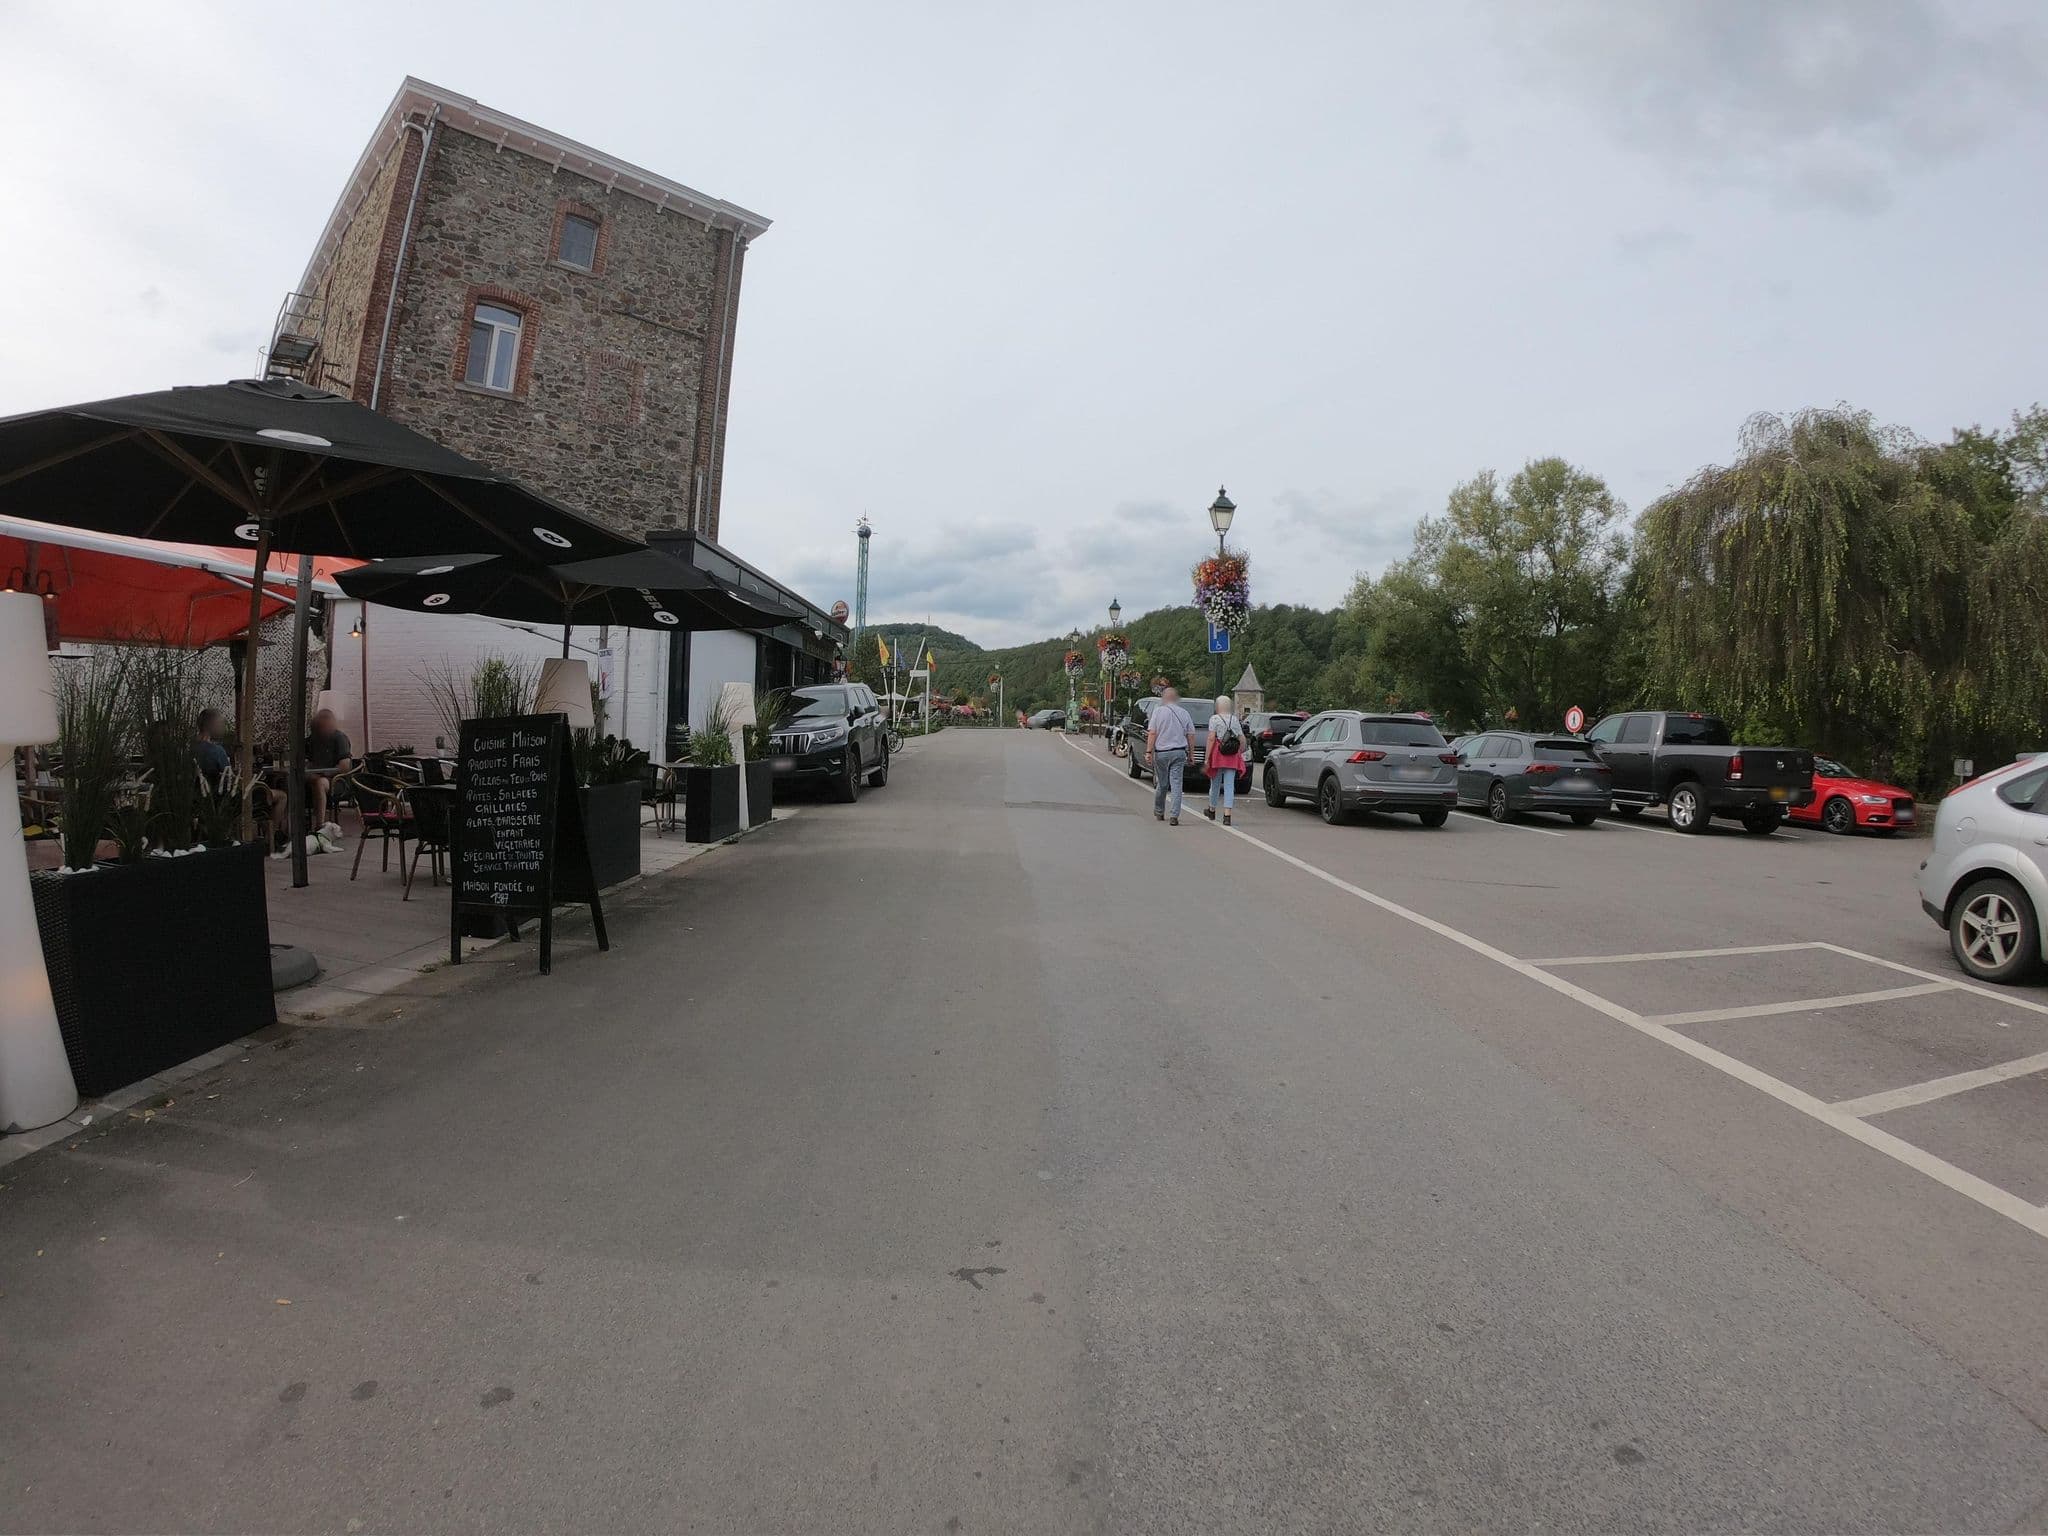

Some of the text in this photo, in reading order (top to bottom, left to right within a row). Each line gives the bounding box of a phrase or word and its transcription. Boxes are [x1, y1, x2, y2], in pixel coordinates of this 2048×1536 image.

[467, 753, 541, 771] PRODUITS FRAIS
[498, 788, 538, 801] SALADES
[496, 828, 525, 839] ENFANT
[472, 860, 540, 874] SERVICE TRAITEUR
[462, 880, 490, 893] MAISON
[494, 879, 522, 893] FONDÉE
